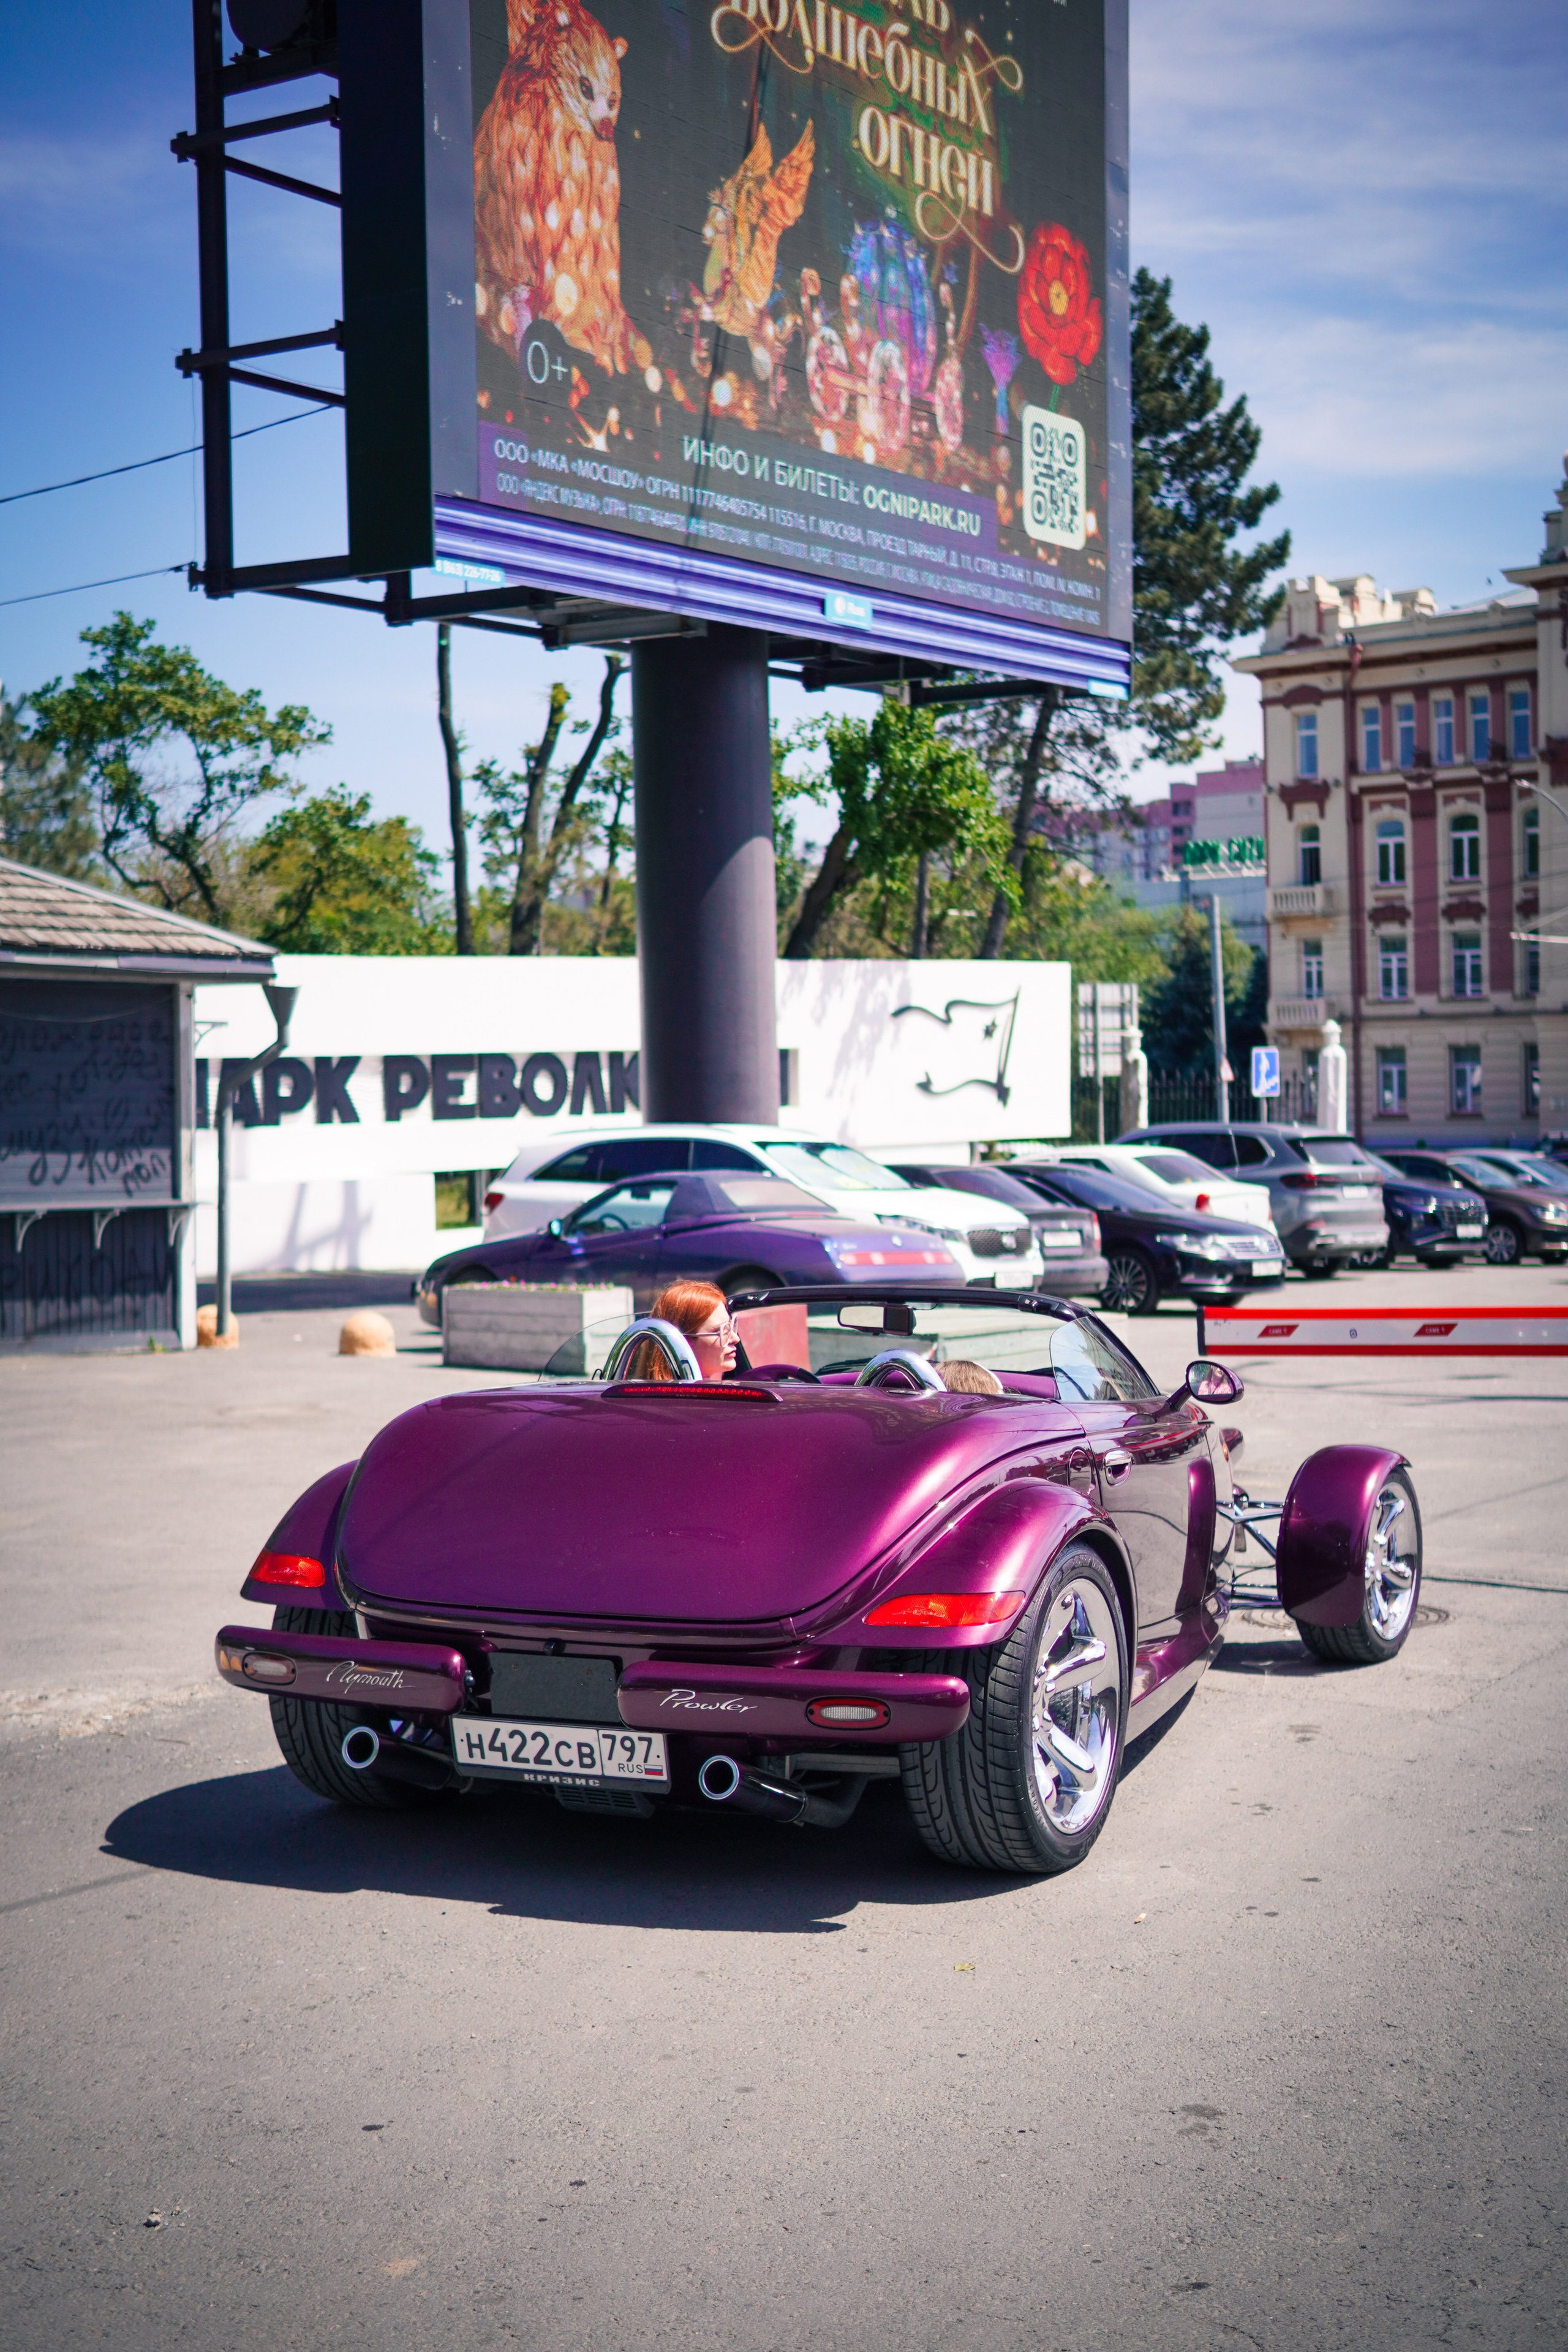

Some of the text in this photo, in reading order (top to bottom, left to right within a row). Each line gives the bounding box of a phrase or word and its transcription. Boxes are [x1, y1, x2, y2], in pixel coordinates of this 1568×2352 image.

[527, 341, 568, 384] 0+
[494, 438, 529, 464] ООО
[530, 447, 569, 473] «МКА
[570, 456, 644, 491] «МОСШОУ»
[646, 475, 678, 500] ОГРН
[682, 435, 981, 537] ИНФО И БИЛЕТЫ: OGNIPARK.RU
[326, 1660, 417, 1694] Plymouth
[659, 1689, 759, 1714] Prowler
[602, 1734, 652, 1763] 797
[524, 1773, 600, 1787] КРИЗИС
[618, 1763, 644, 1774] RUS
